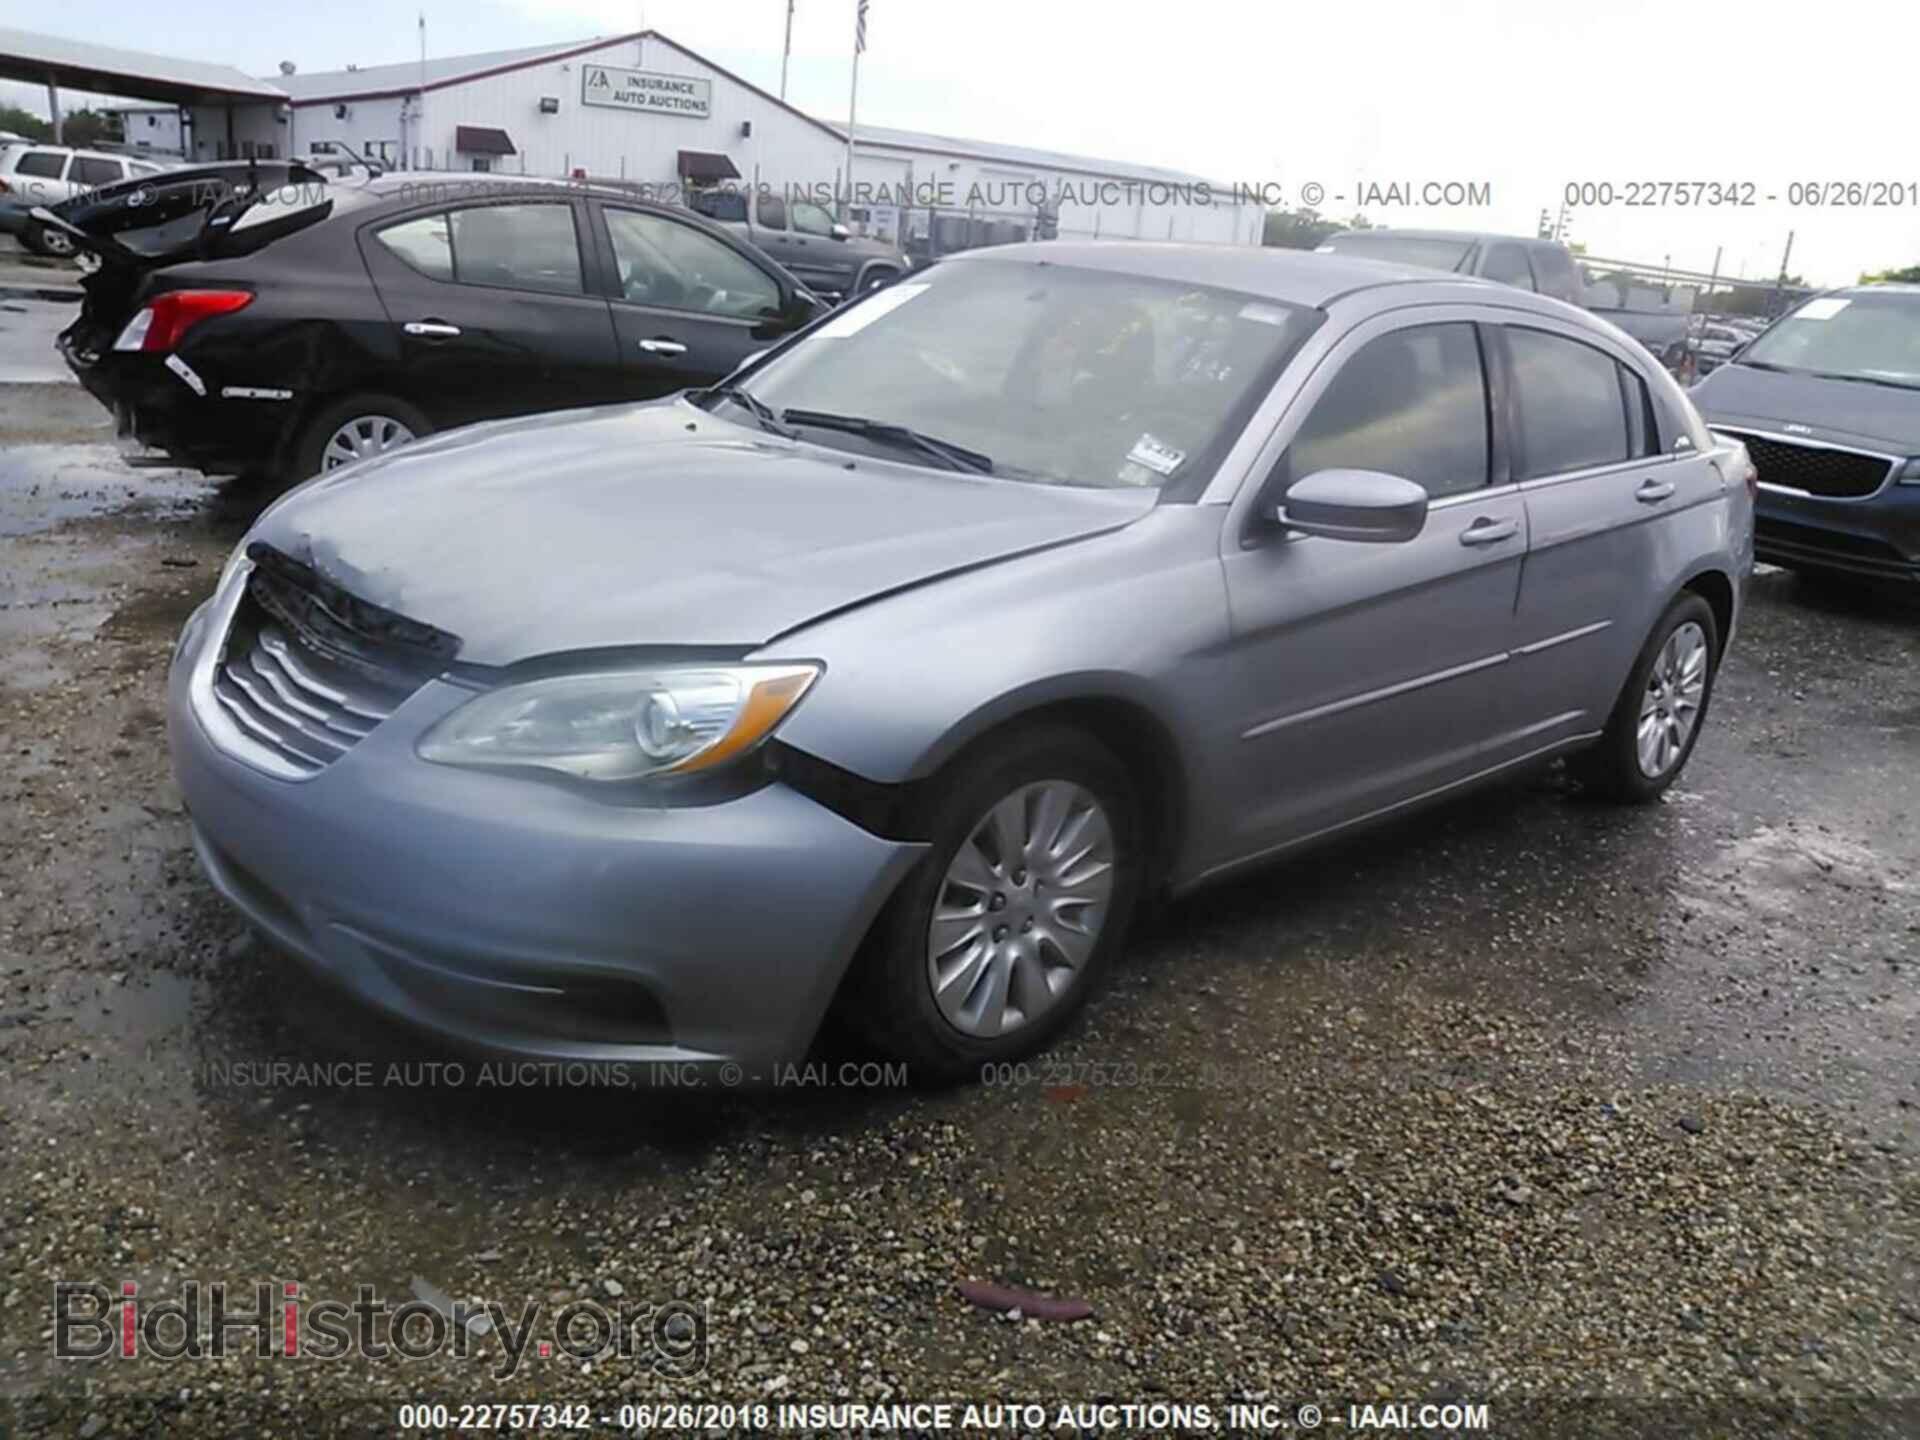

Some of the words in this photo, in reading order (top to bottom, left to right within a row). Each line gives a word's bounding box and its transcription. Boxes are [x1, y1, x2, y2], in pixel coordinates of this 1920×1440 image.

[626, 76, 695, 95] INSURANCE
[613, 91, 646, 105] AUTO
[647, 95, 708, 112] AUCTIONS
